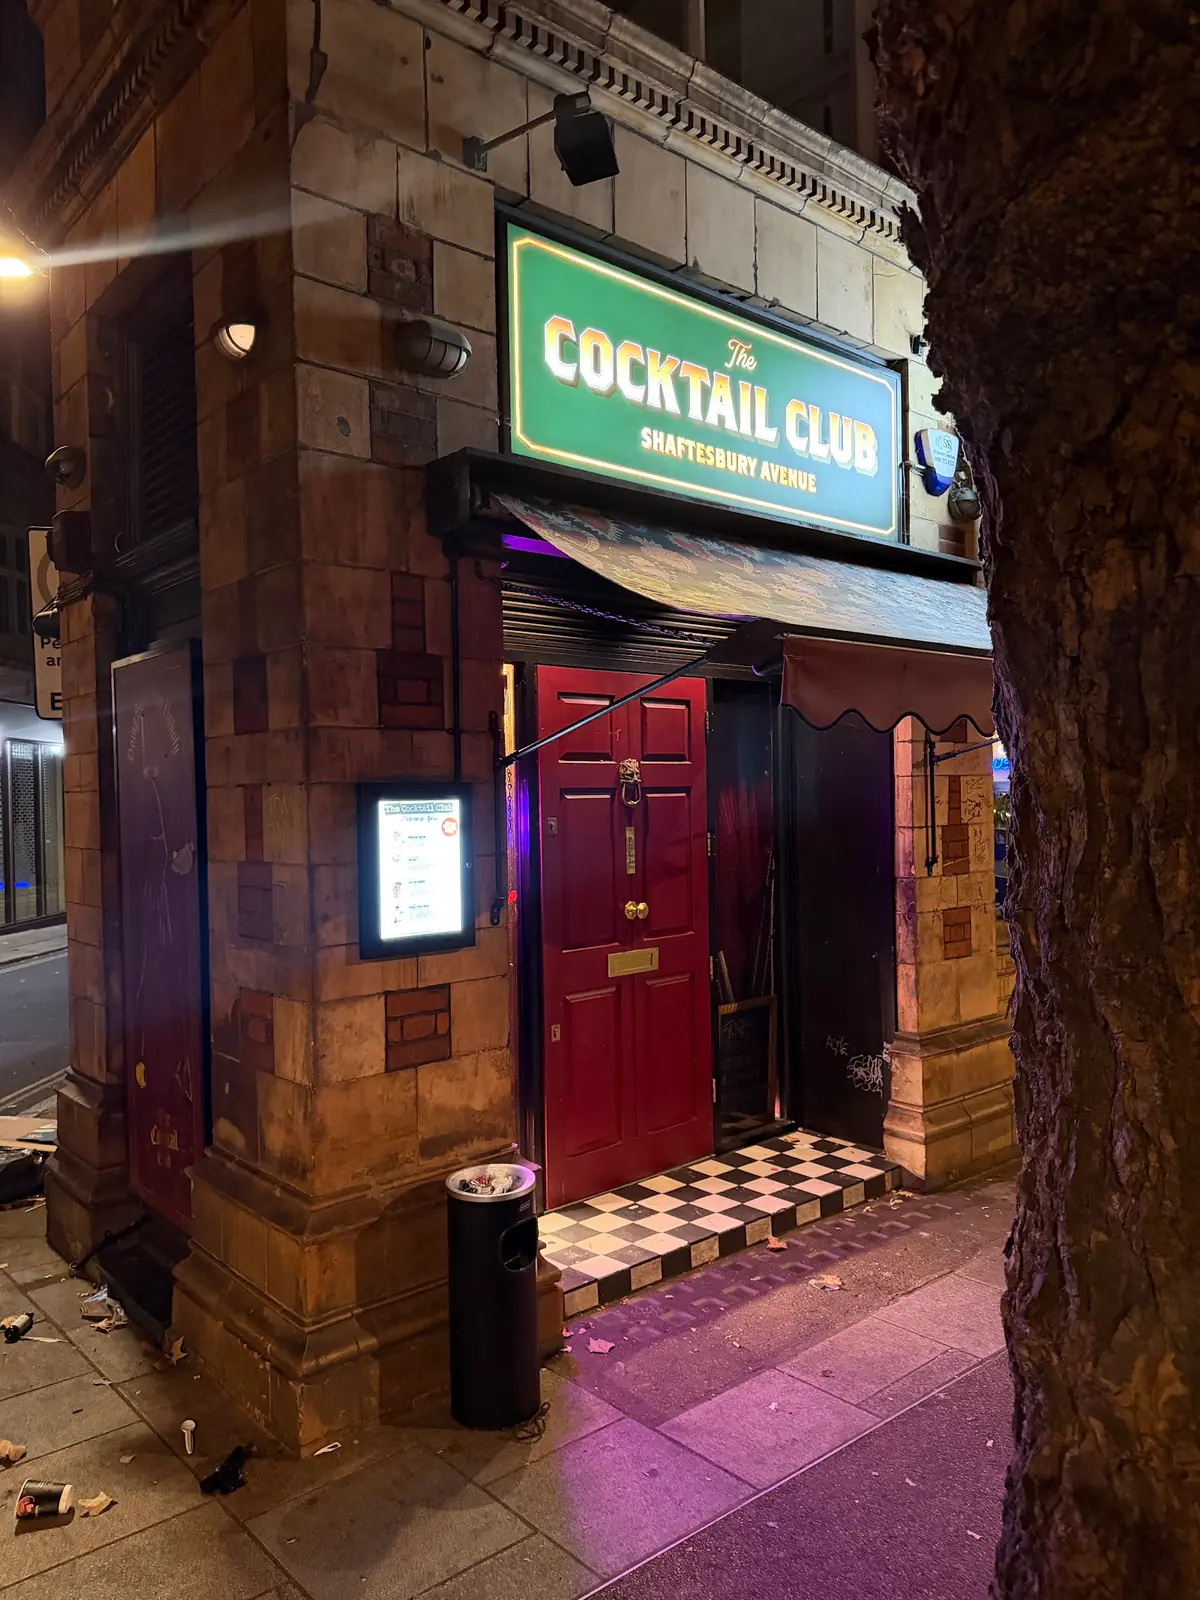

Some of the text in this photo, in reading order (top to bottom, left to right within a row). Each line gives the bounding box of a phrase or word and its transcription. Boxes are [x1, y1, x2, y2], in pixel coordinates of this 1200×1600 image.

[725, 338, 757, 371] The
[544, 315, 877, 474] COCKTAIL CLUB
[641, 426, 817, 494] SHAFTESBURY AVENUE
[401, 804, 434, 812] Cocktail
